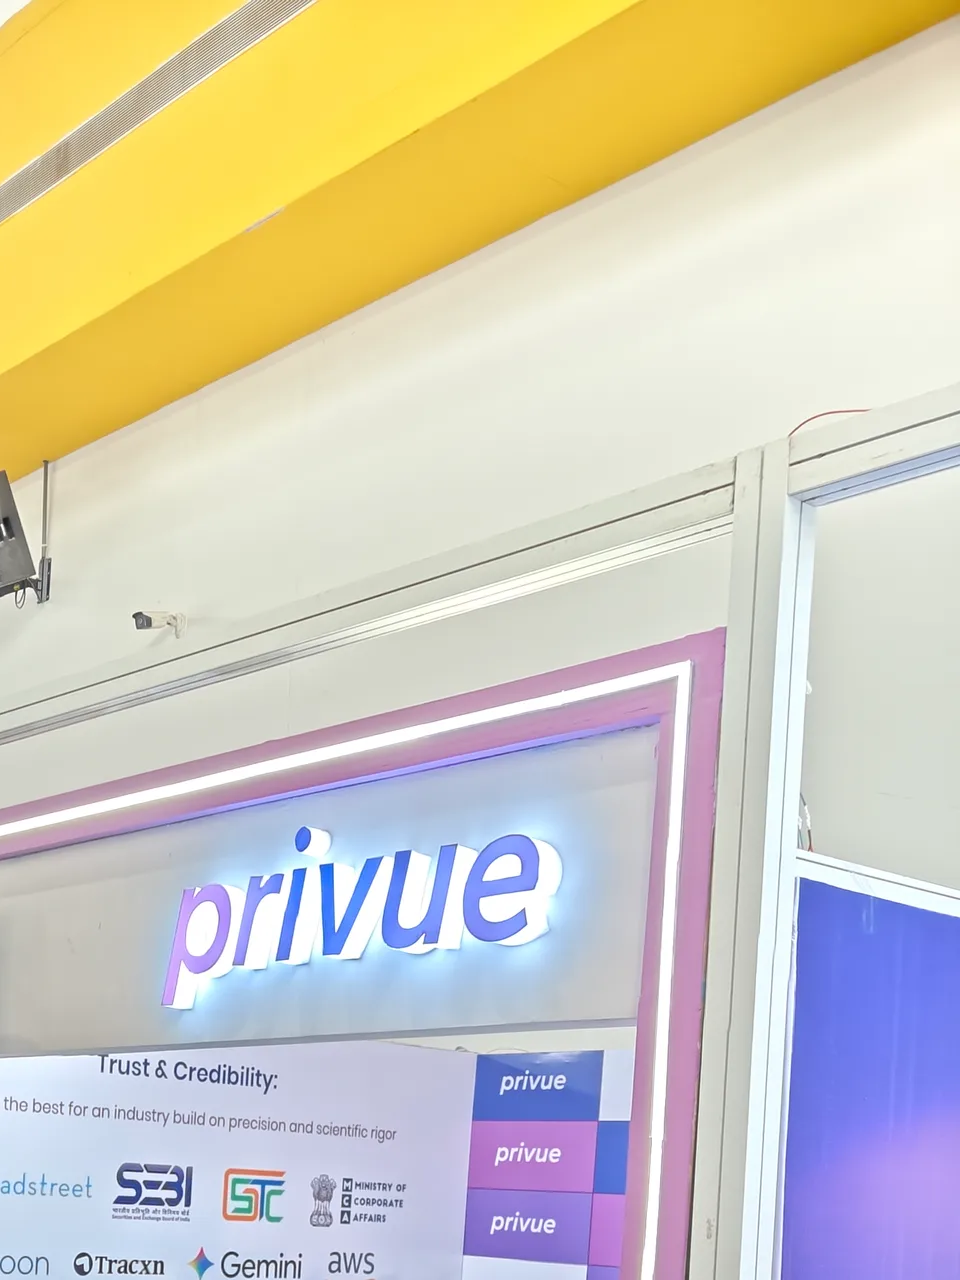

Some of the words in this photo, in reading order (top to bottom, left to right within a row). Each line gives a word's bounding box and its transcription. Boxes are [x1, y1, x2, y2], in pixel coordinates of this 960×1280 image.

[161, 826, 563, 1010] privue
[98, 1054, 150, 1076] Trust
[155, 1060, 168, 1080] &
[173, 1061, 278, 1094] Credibility:
[499, 1069, 567, 1096] privue
[3, 1096, 28, 1112] the
[32, 1098, 65, 1115] best
[68, 1101, 89, 1117] for
[92, 1105, 110, 1119] an
[114, 1105, 170, 1127] industry
[173, 1108, 206, 1126] build
[209, 1114, 225, 1127] on
[229, 1114, 286, 1135] precision
[289, 1118, 313, 1134] and
[316, 1120, 368, 1139] scientific
[371, 1124, 397, 1143] rigor
[494, 1142, 562, 1167] privue
[112, 1163, 193, 1207] SEBI
[354, 1181, 393, 1192] MINISTRY
[396, 1184, 407, 1193] OF
[354, 1197, 404, 1208] CORPORATE
[352, 1213, 386, 1223] AFFAIRS
[490, 1212, 557, 1236] privue
[95, 1255, 165, 1277] Tracxn
[220, 1251, 303, 1280] Gemini
[328, 1252, 376, 1276] aws
